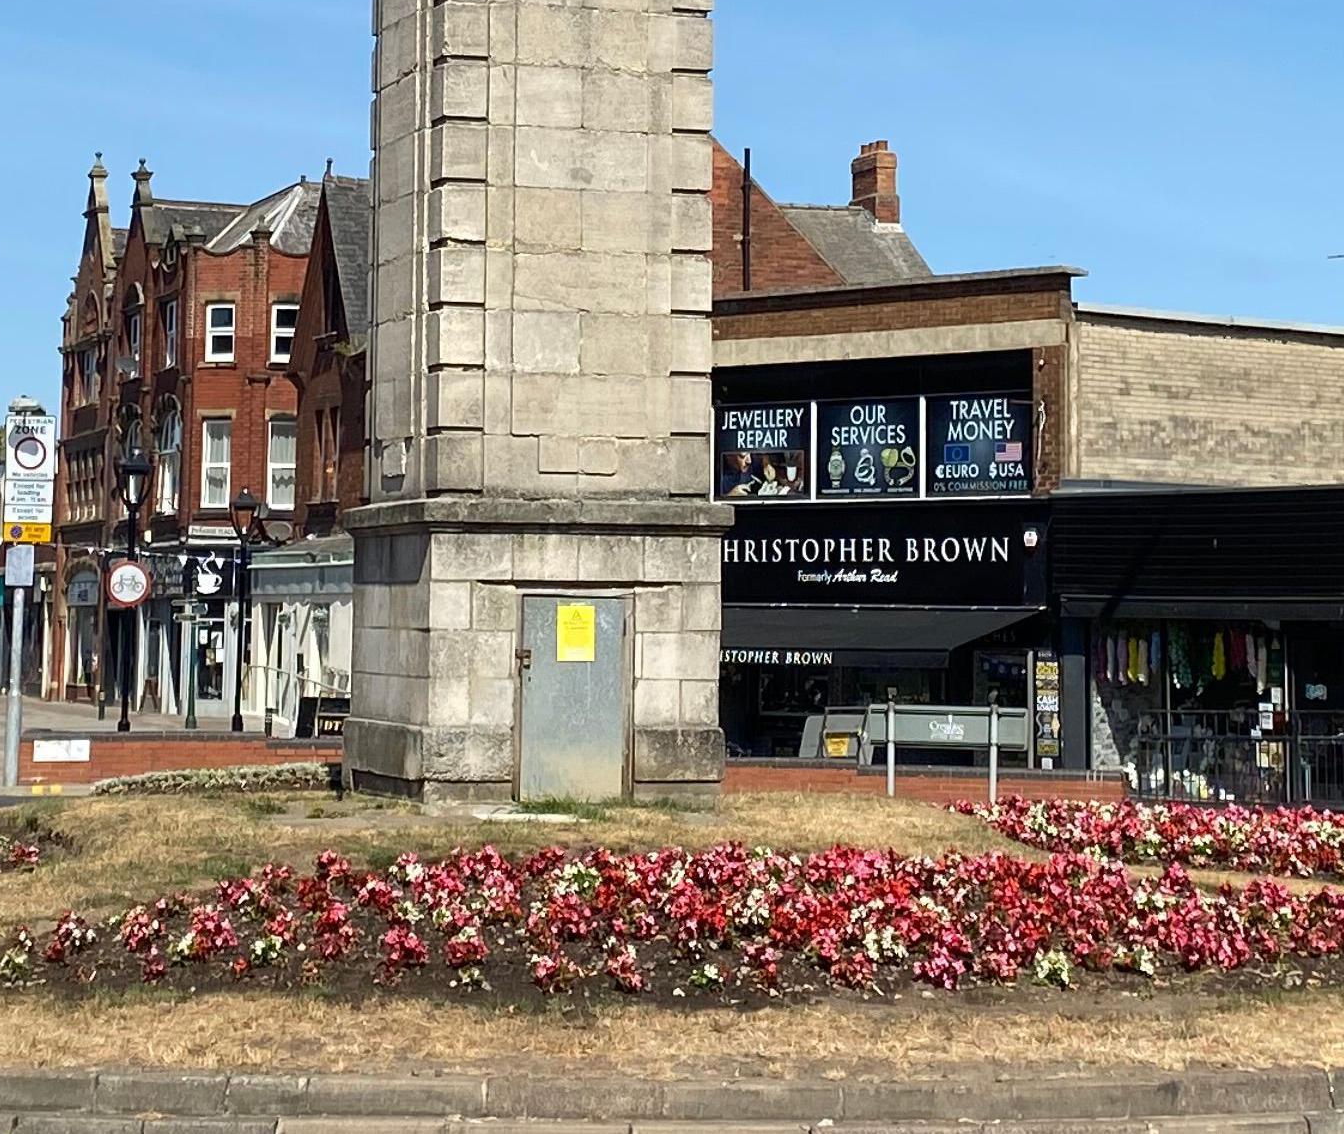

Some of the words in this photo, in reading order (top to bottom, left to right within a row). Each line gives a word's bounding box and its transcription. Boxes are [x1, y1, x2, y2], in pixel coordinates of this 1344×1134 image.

[722, 408, 804, 430] JEWELLERY
[850, 405, 886, 425] OUR
[950, 398, 1011, 420] TRAVEL
[15, 426, 46, 434] ZONE
[737, 429, 788, 449] REPAIR
[831, 425, 906, 446] SERVICES
[947, 419, 1015, 441] MONEY
[723, 538, 894, 563] HRISTOPHER
[905, 537, 1009, 563] BROWN
[797, 569, 832, 585] Formerly
[720, 650, 779, 664] ISTOPHER
[785, 652, 832, 665] BROWN
[1037, 695, 1059, 704] CASH
